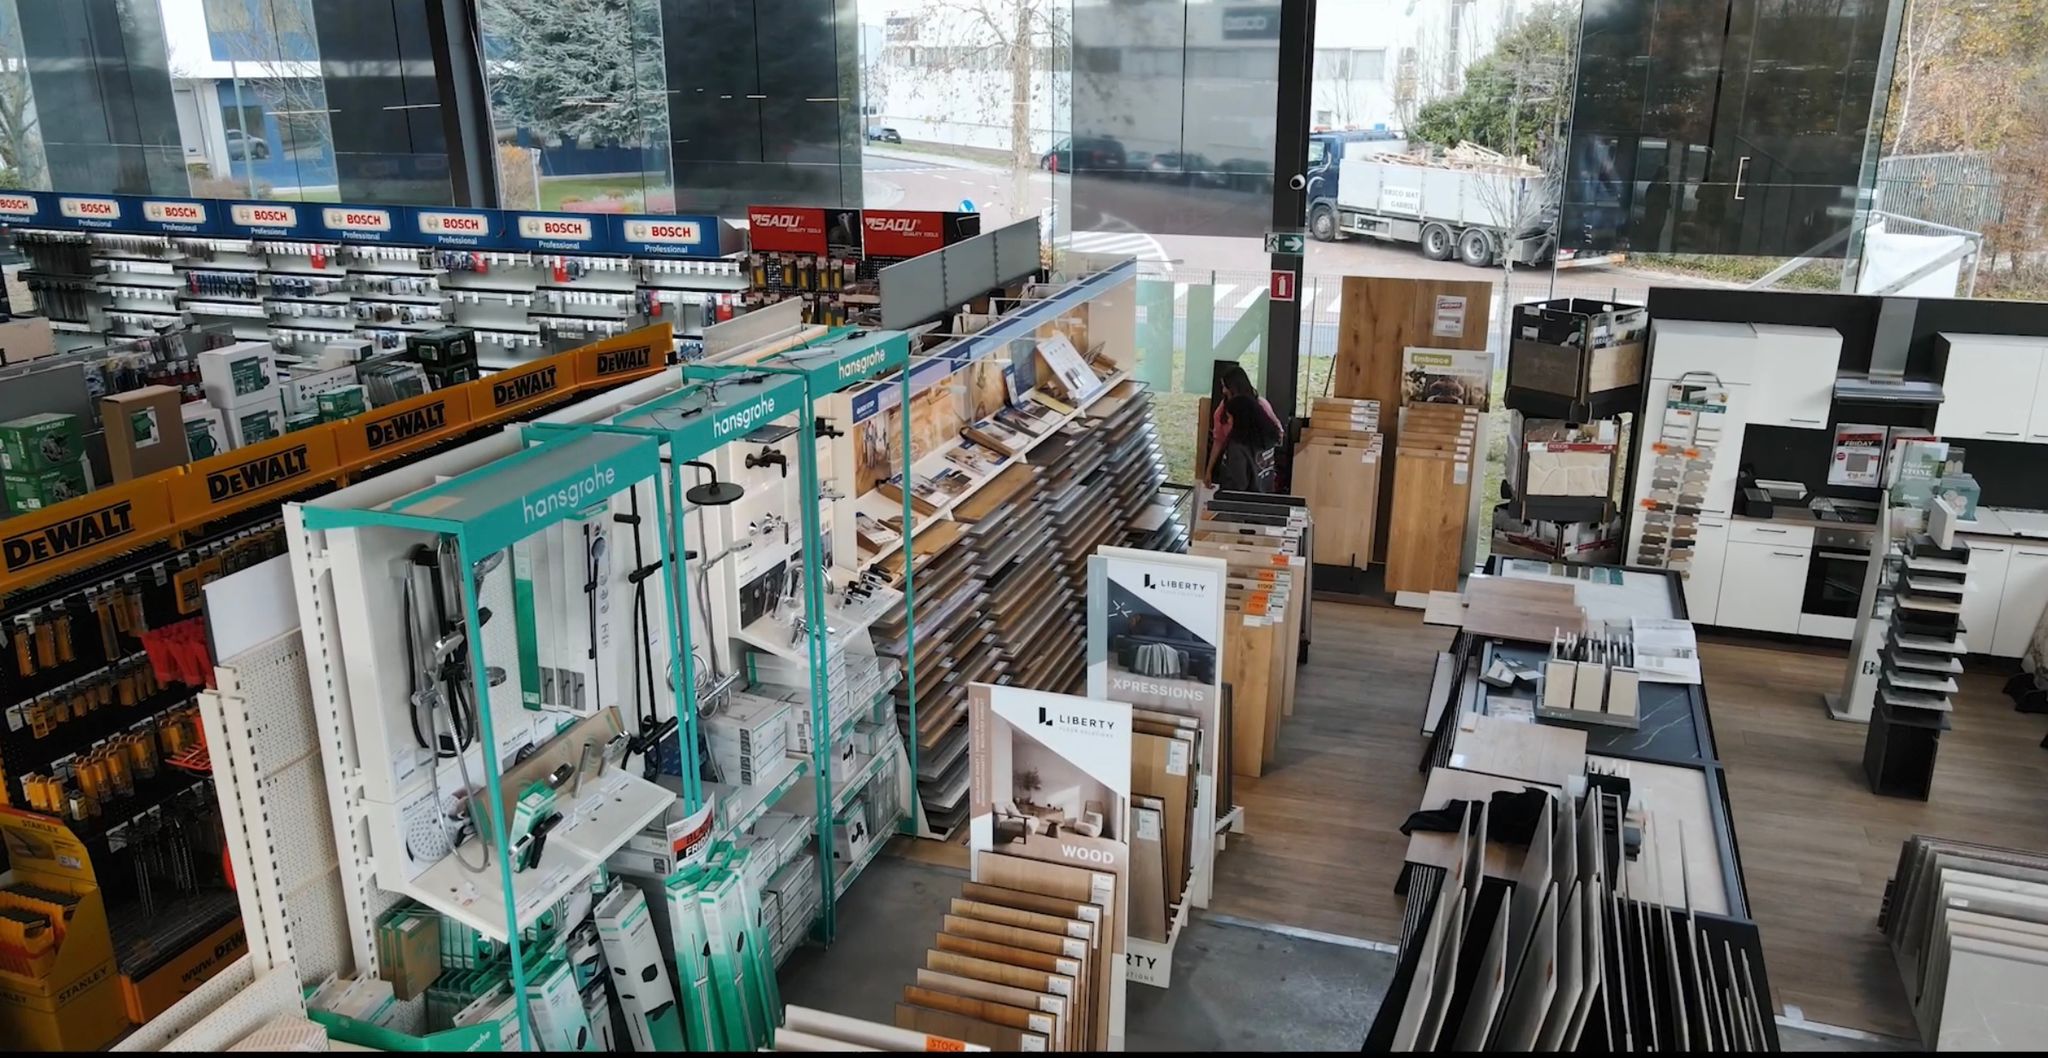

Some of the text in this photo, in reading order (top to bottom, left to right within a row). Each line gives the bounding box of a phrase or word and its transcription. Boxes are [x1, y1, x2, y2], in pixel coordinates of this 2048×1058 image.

[80, 202, 111, 214] BOSCH
[165, 206, 197, 218] BOSCH
[254, 210, 288, 221] BOSCH
[346, 214, 381, 225] BOSCH
[443, 218, 479, 230] BOSCH
[545, 222, 582, 235] BOSCH
[250, 226, 288, 237] Professional
[342, 230, 380, 241] Professional
[652, 226, 691, 239] BOSCH
[438, 235, 478, 246] Professional
[539, 240, 580, 250] Professional
[644, 243, 688, 254] Professional
[838, 346, 886, 380] hansgrohe
[1414, 354, 1450, 365] Embrace
[713, 392, 776, 438] hansgrohe
[522, 463, 616, 524] hansgrohe
[1160, 578, 1206, 592] LIBERTY
[1112, 677, 1204, 701] XPRESSIONS
[1059, 714, 1115, 730] LIBERTY
[22, 819, 59, 834] STANLEY
[1061, 843, 1115, 865] WOOD
[58, 964, 109, 1004] STANLEY
